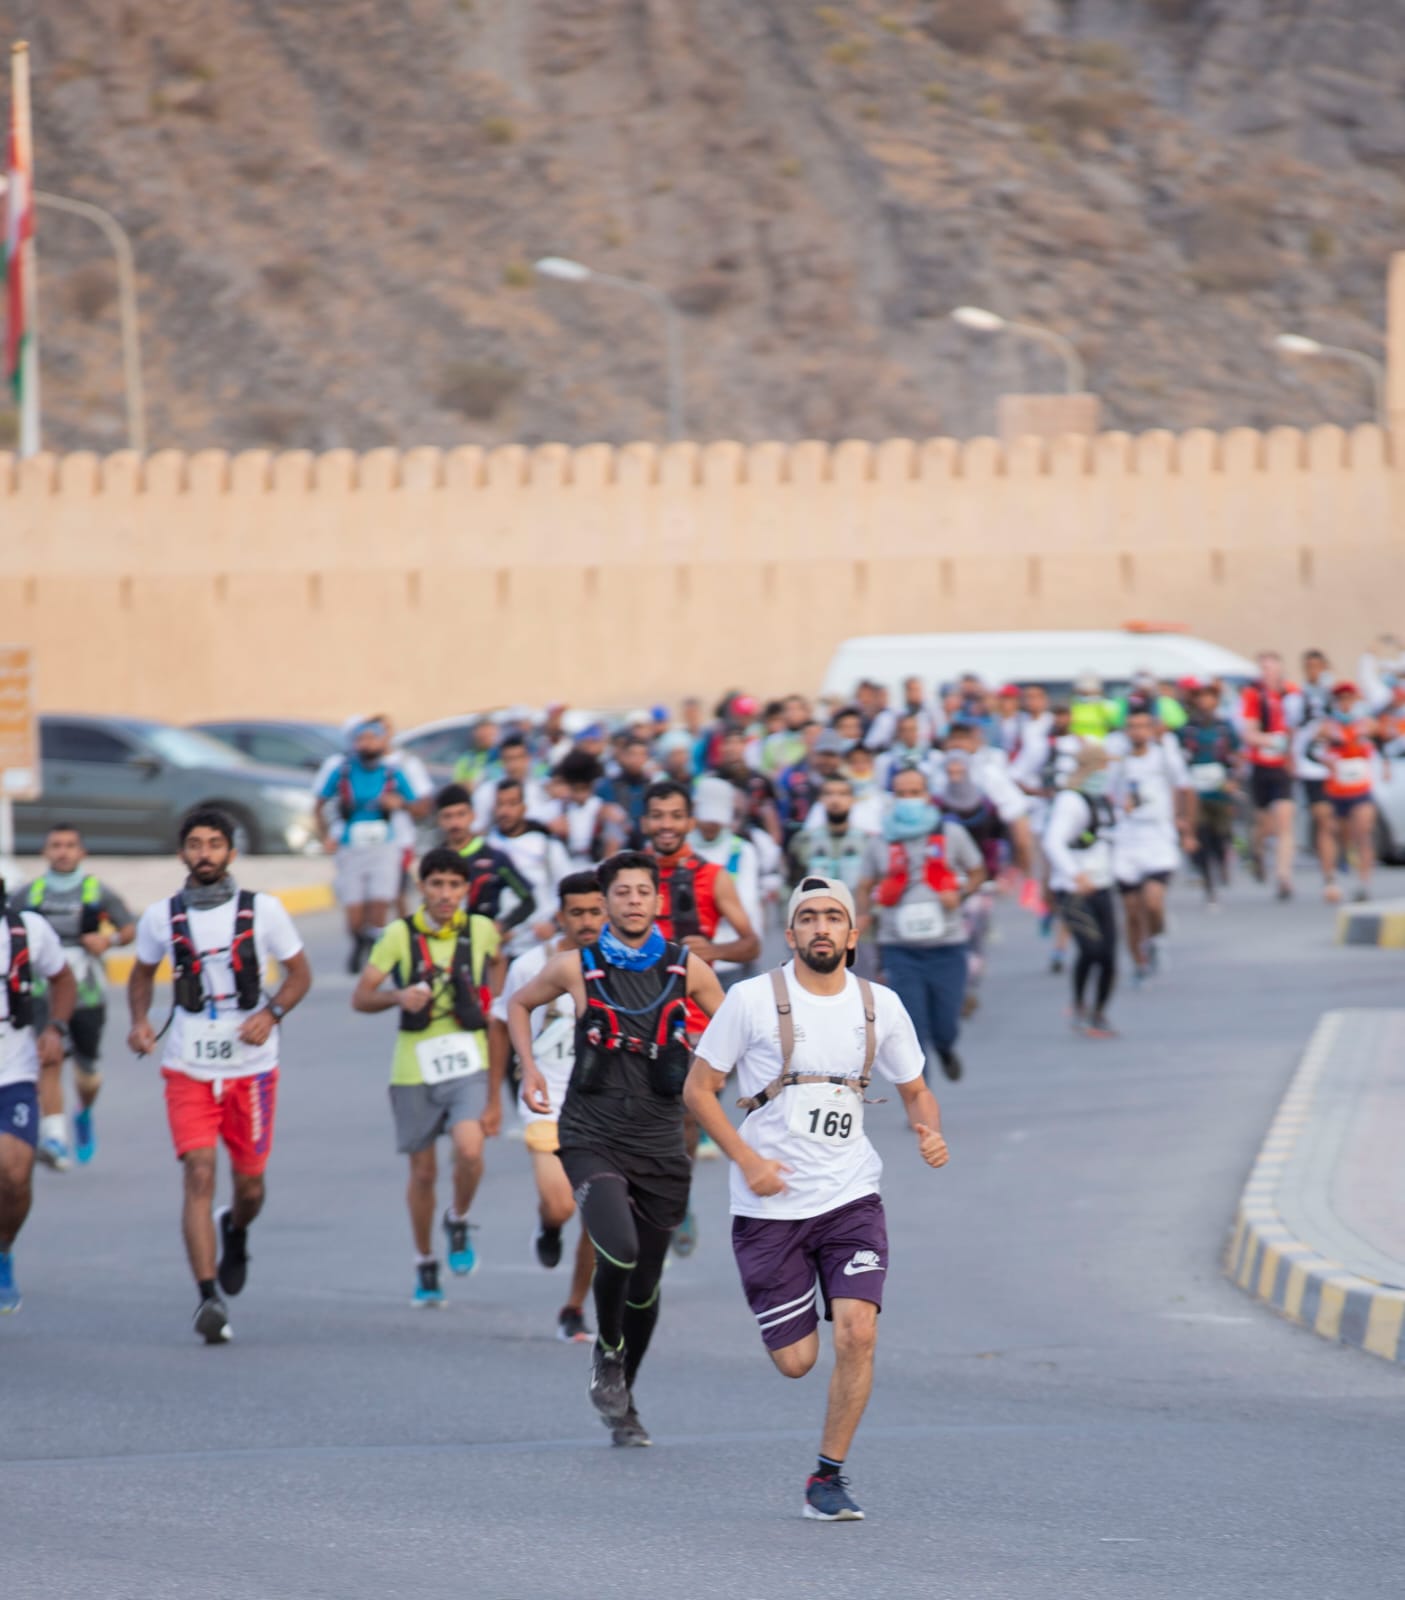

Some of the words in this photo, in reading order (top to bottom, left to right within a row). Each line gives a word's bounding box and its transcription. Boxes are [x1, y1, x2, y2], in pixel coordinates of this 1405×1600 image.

[194, 1039, 233, 1060] 158
[432, 1050, 470, 1076] 179
[807, 1107, 853, 1139] 169
